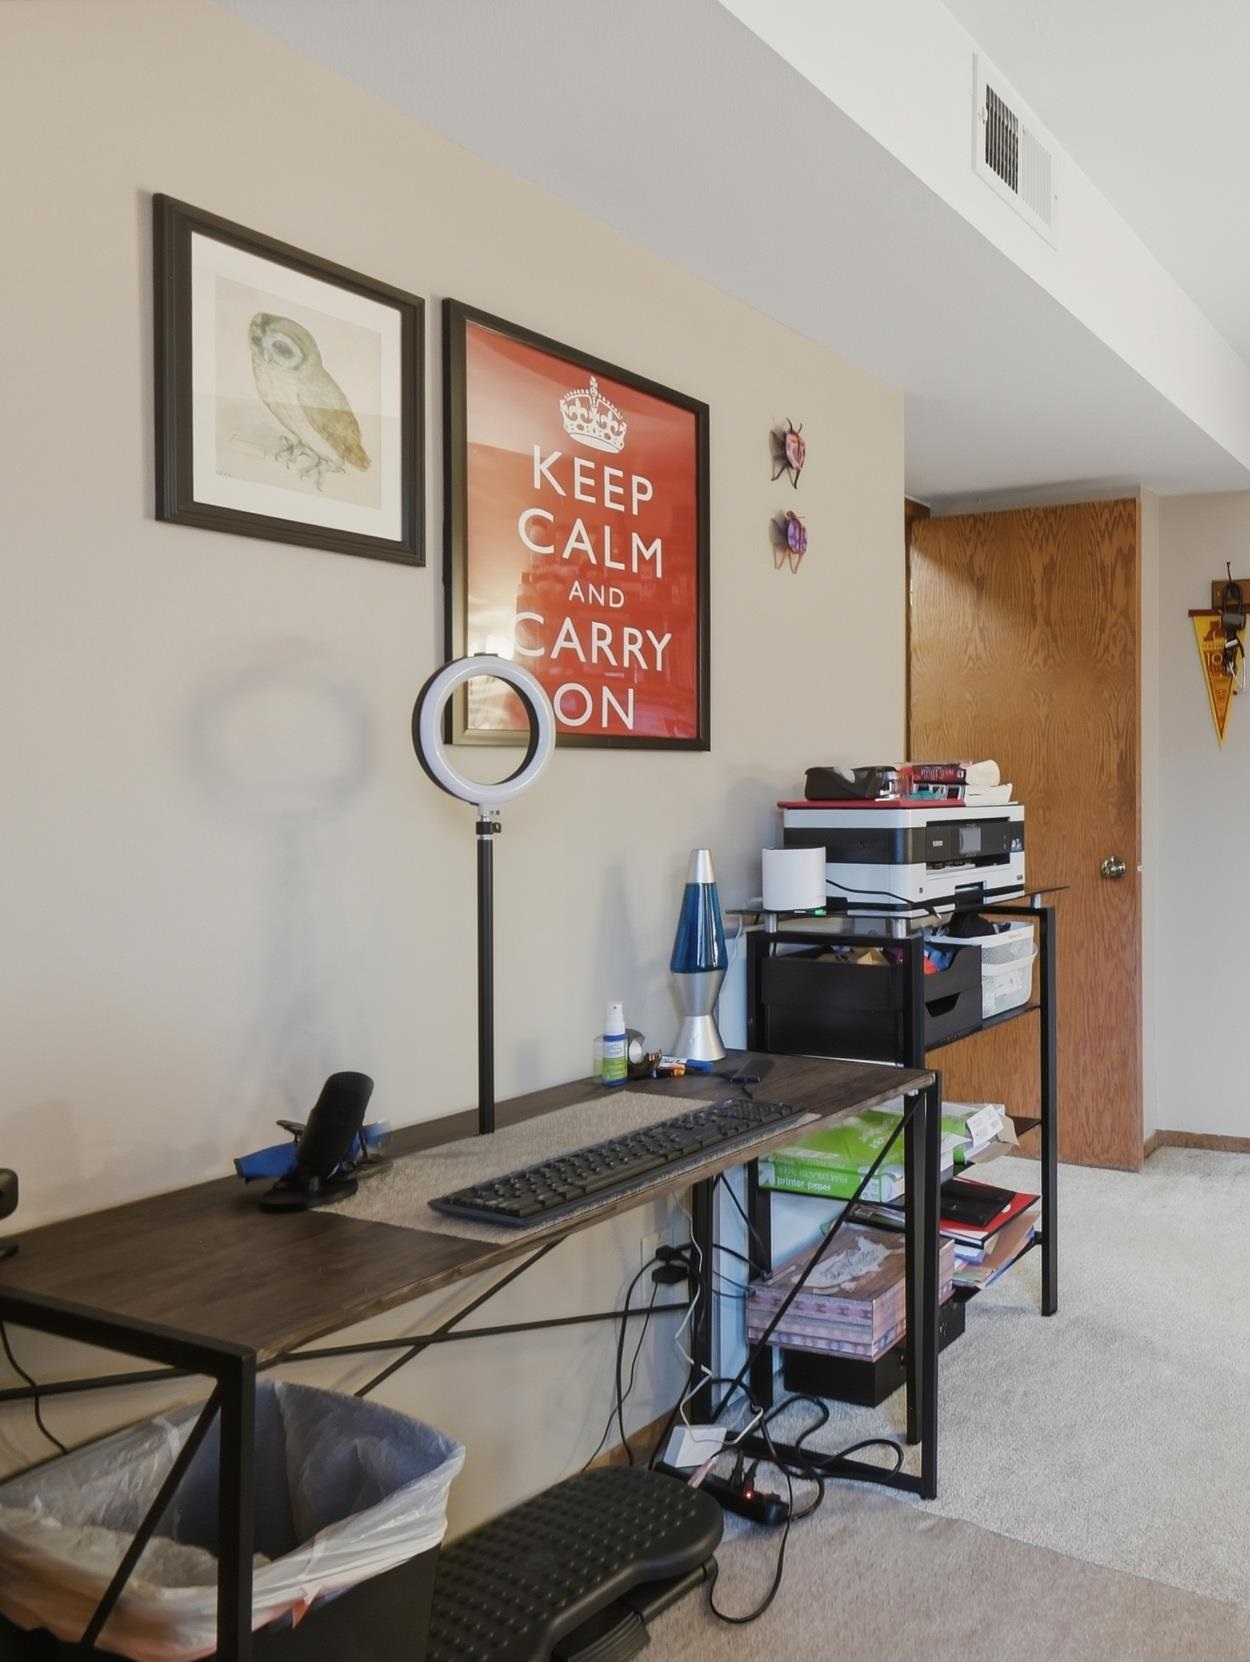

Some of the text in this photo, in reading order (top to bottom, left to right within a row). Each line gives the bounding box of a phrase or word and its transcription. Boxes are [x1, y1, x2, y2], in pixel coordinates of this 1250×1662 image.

[533, 445, 654, 516] KEEP
[517, 508, 663, 579] CALM
[568, 580, 625, 608] AND
[512, 611, 672, 672] CARRY
[553, 682, 635, 731] ON
[776, 1177, 831, 1191] printer paper
